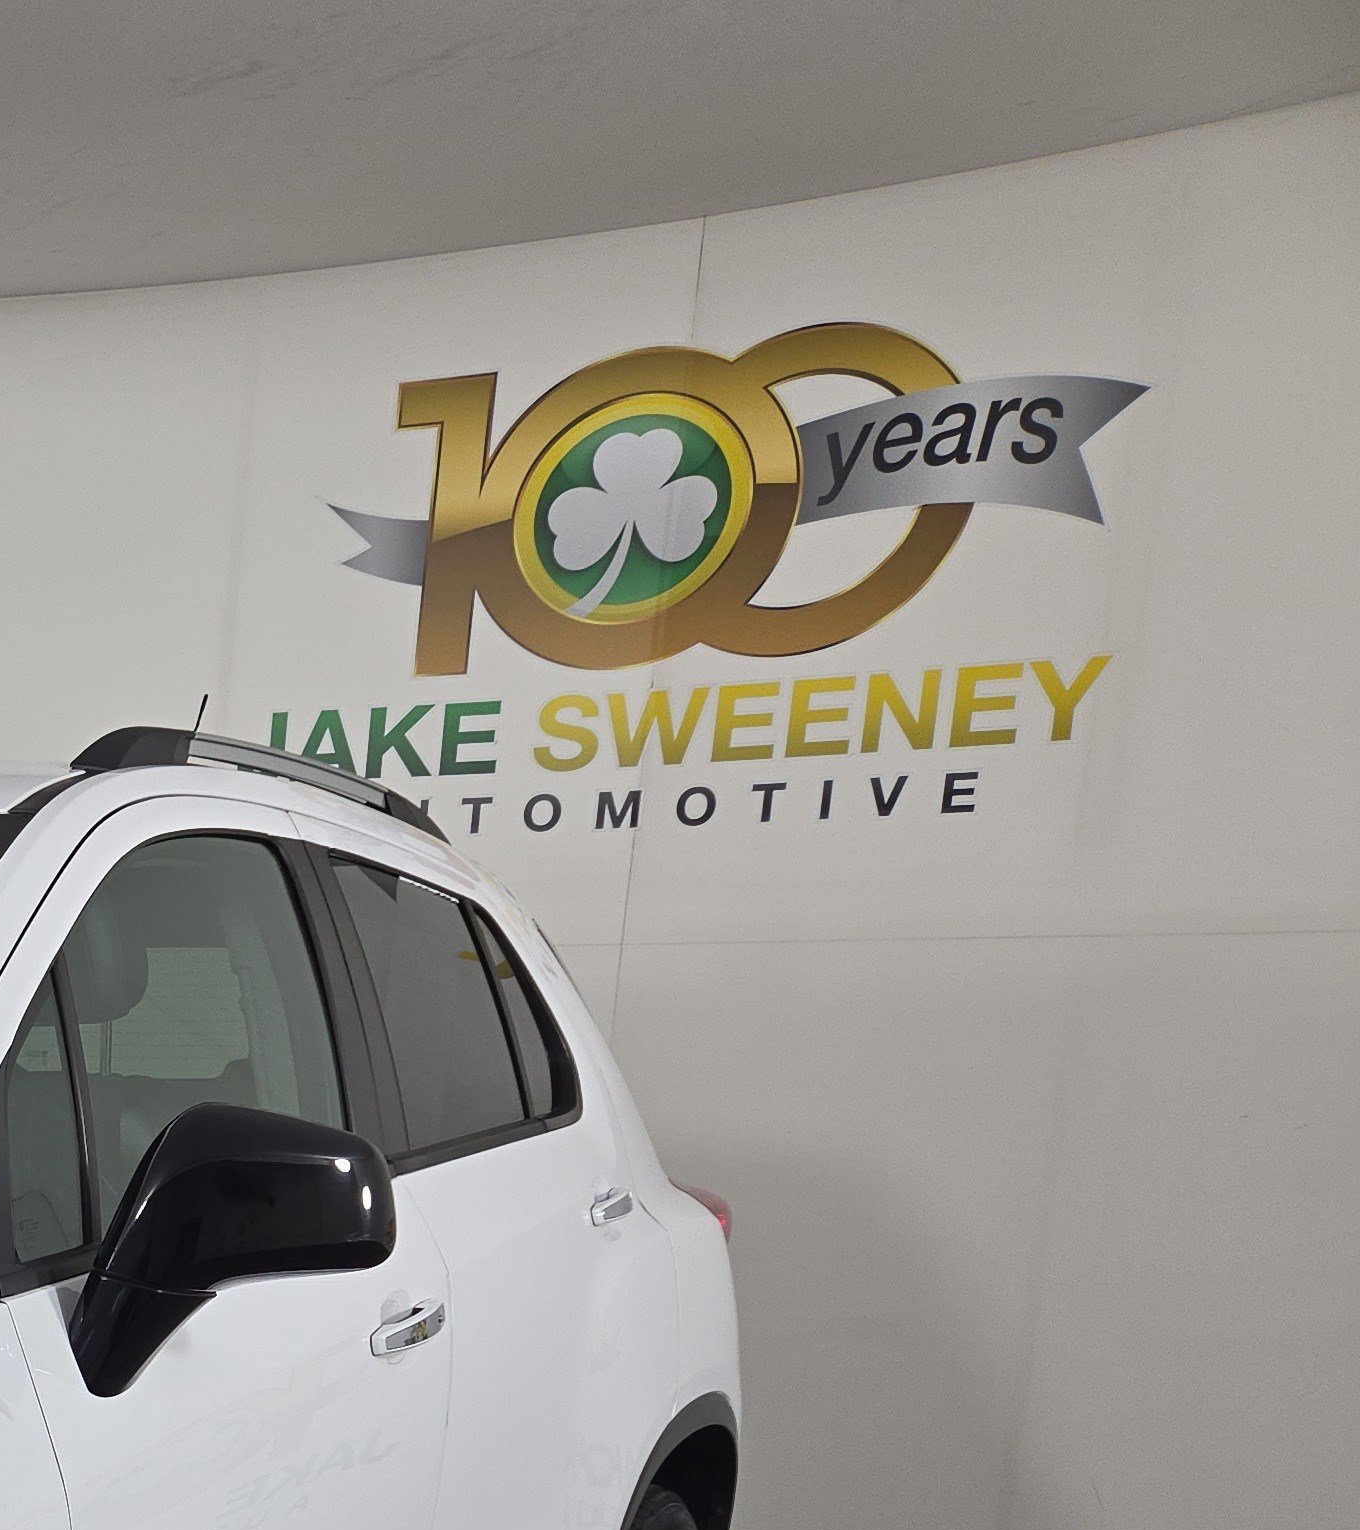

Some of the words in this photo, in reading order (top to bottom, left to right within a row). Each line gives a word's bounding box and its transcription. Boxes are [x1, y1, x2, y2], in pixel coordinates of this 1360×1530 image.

[396, 321, 977, 677] 100
[816, 397, 1064, 506] years
[531, 655, 1114, 774] SWEENEY
[420, 771, 982, 835] TOMOTIVE
